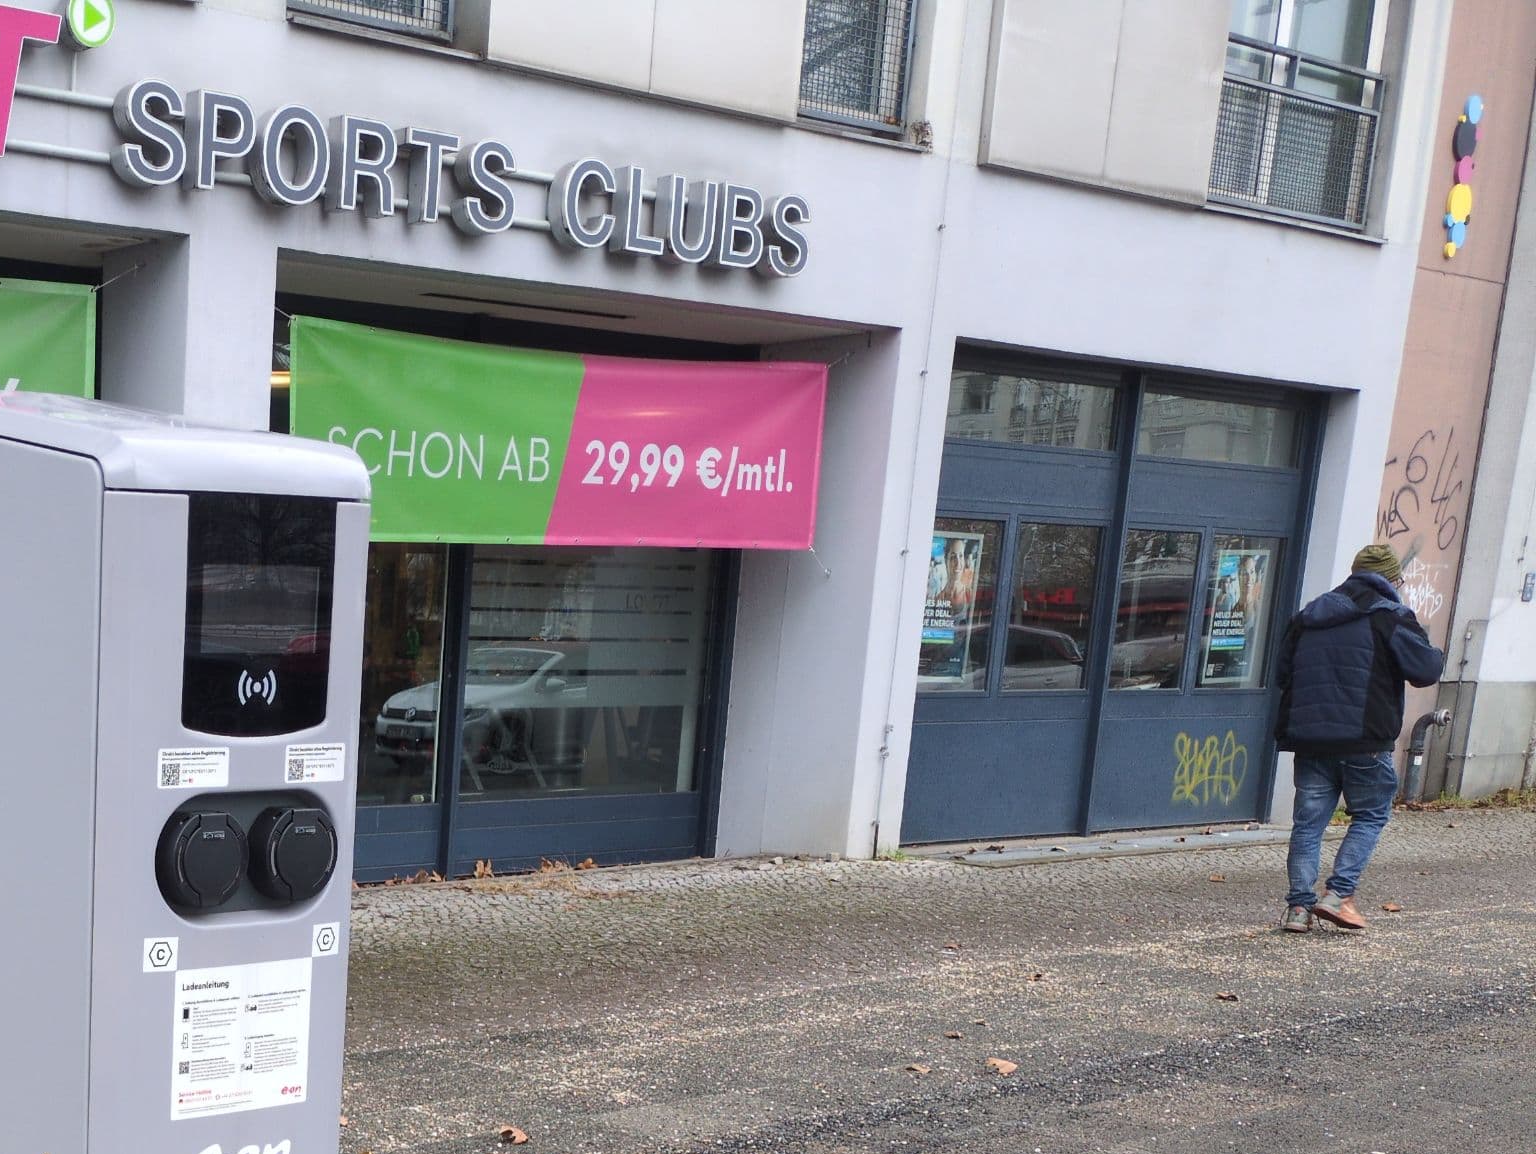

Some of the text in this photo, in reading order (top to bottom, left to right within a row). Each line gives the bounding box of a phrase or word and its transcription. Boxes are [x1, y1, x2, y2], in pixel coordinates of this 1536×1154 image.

[114, 77, 812, 278] SPORTS CLUBS
[497, 435, 550, 482] AB
[581, 439, 793, 497] 29,99 €/mtl.
[322, 934, 330, 945] C
[156, 949, 165, 961] C
[182, 980, 230, 992] Ladeanleitung
